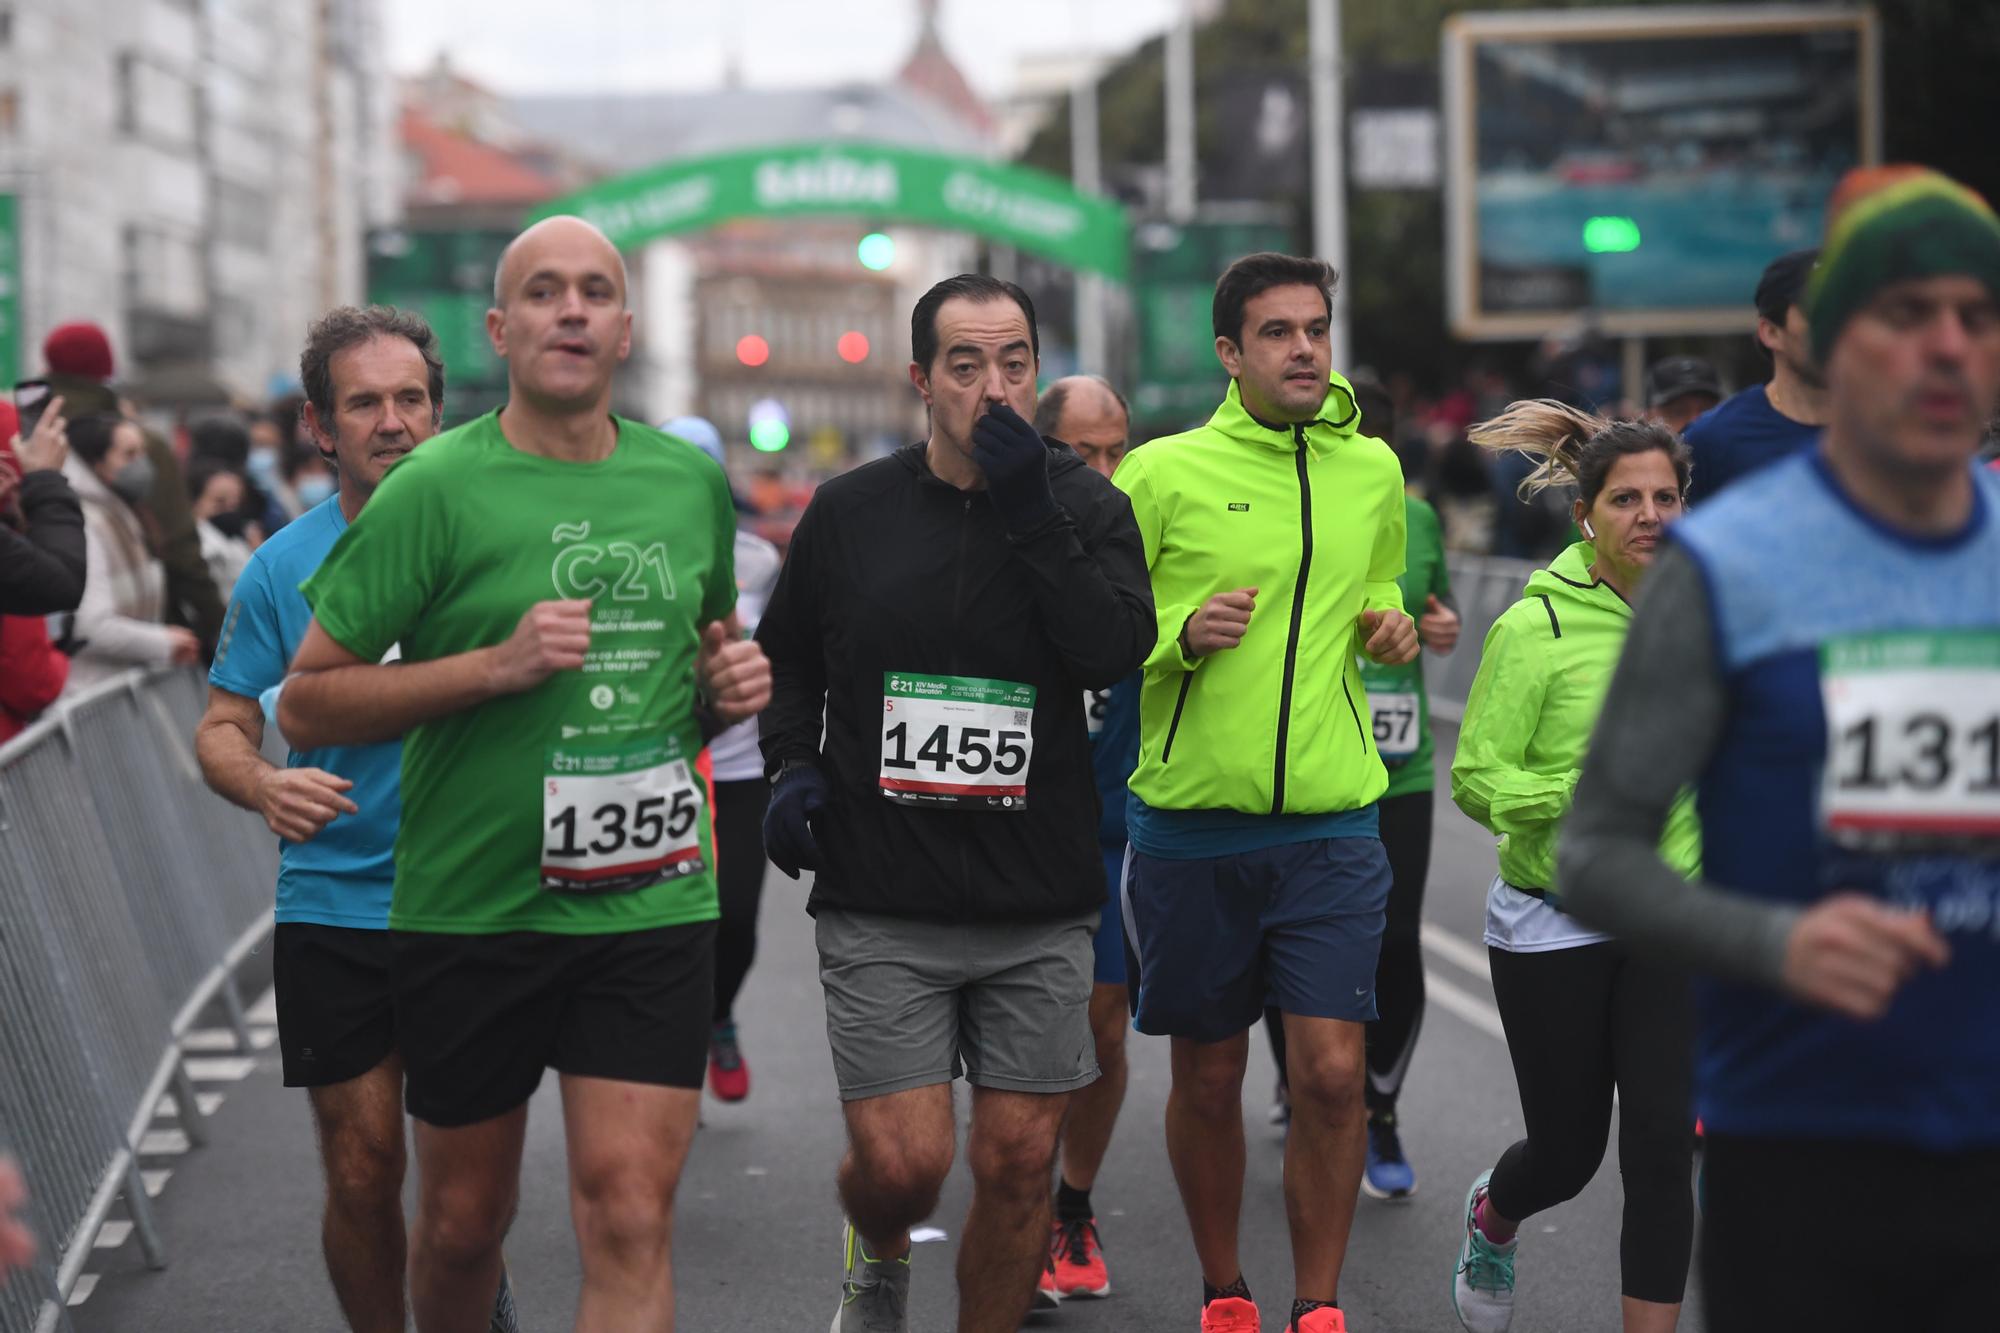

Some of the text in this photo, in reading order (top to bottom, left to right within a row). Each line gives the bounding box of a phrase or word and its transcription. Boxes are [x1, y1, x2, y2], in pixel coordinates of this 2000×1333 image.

[927, 682, 947, 690] Media
[886, 700, 893, 712] 5
[884, 721, 1027, 776] 1455
[547, 788, 697, 858] 1355
